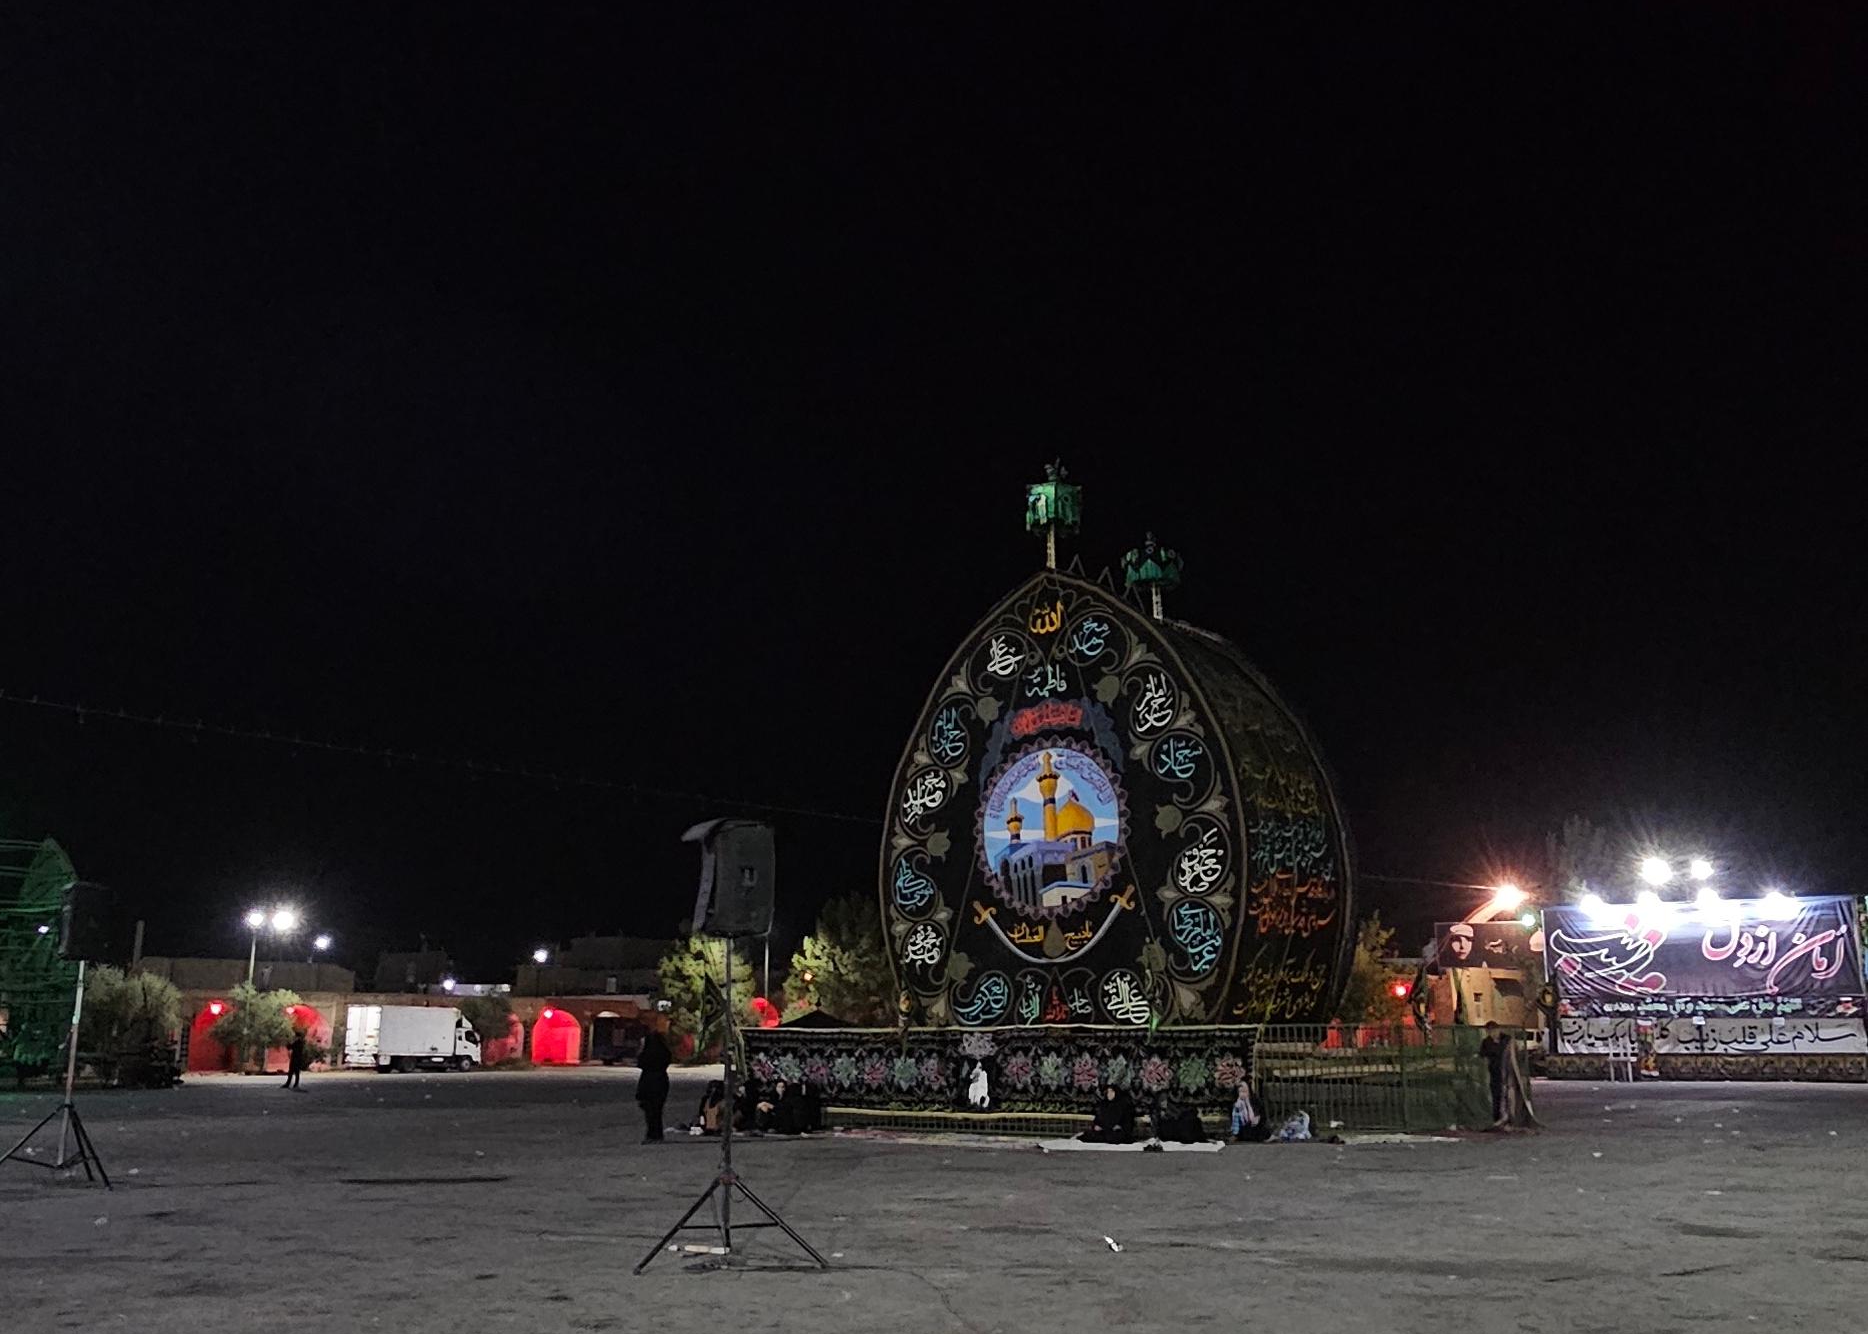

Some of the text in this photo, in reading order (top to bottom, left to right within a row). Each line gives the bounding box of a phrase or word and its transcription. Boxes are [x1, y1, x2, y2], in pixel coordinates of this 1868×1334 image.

[1029, 599, 1063, 634] الله
[1068, 617, 1111, 656] محمد
[1717, 1025, 1758, 1053] قلب
[1727, 1022, 1791, 1052] علی
[1792, 1022, 1857, 1051] سلام
